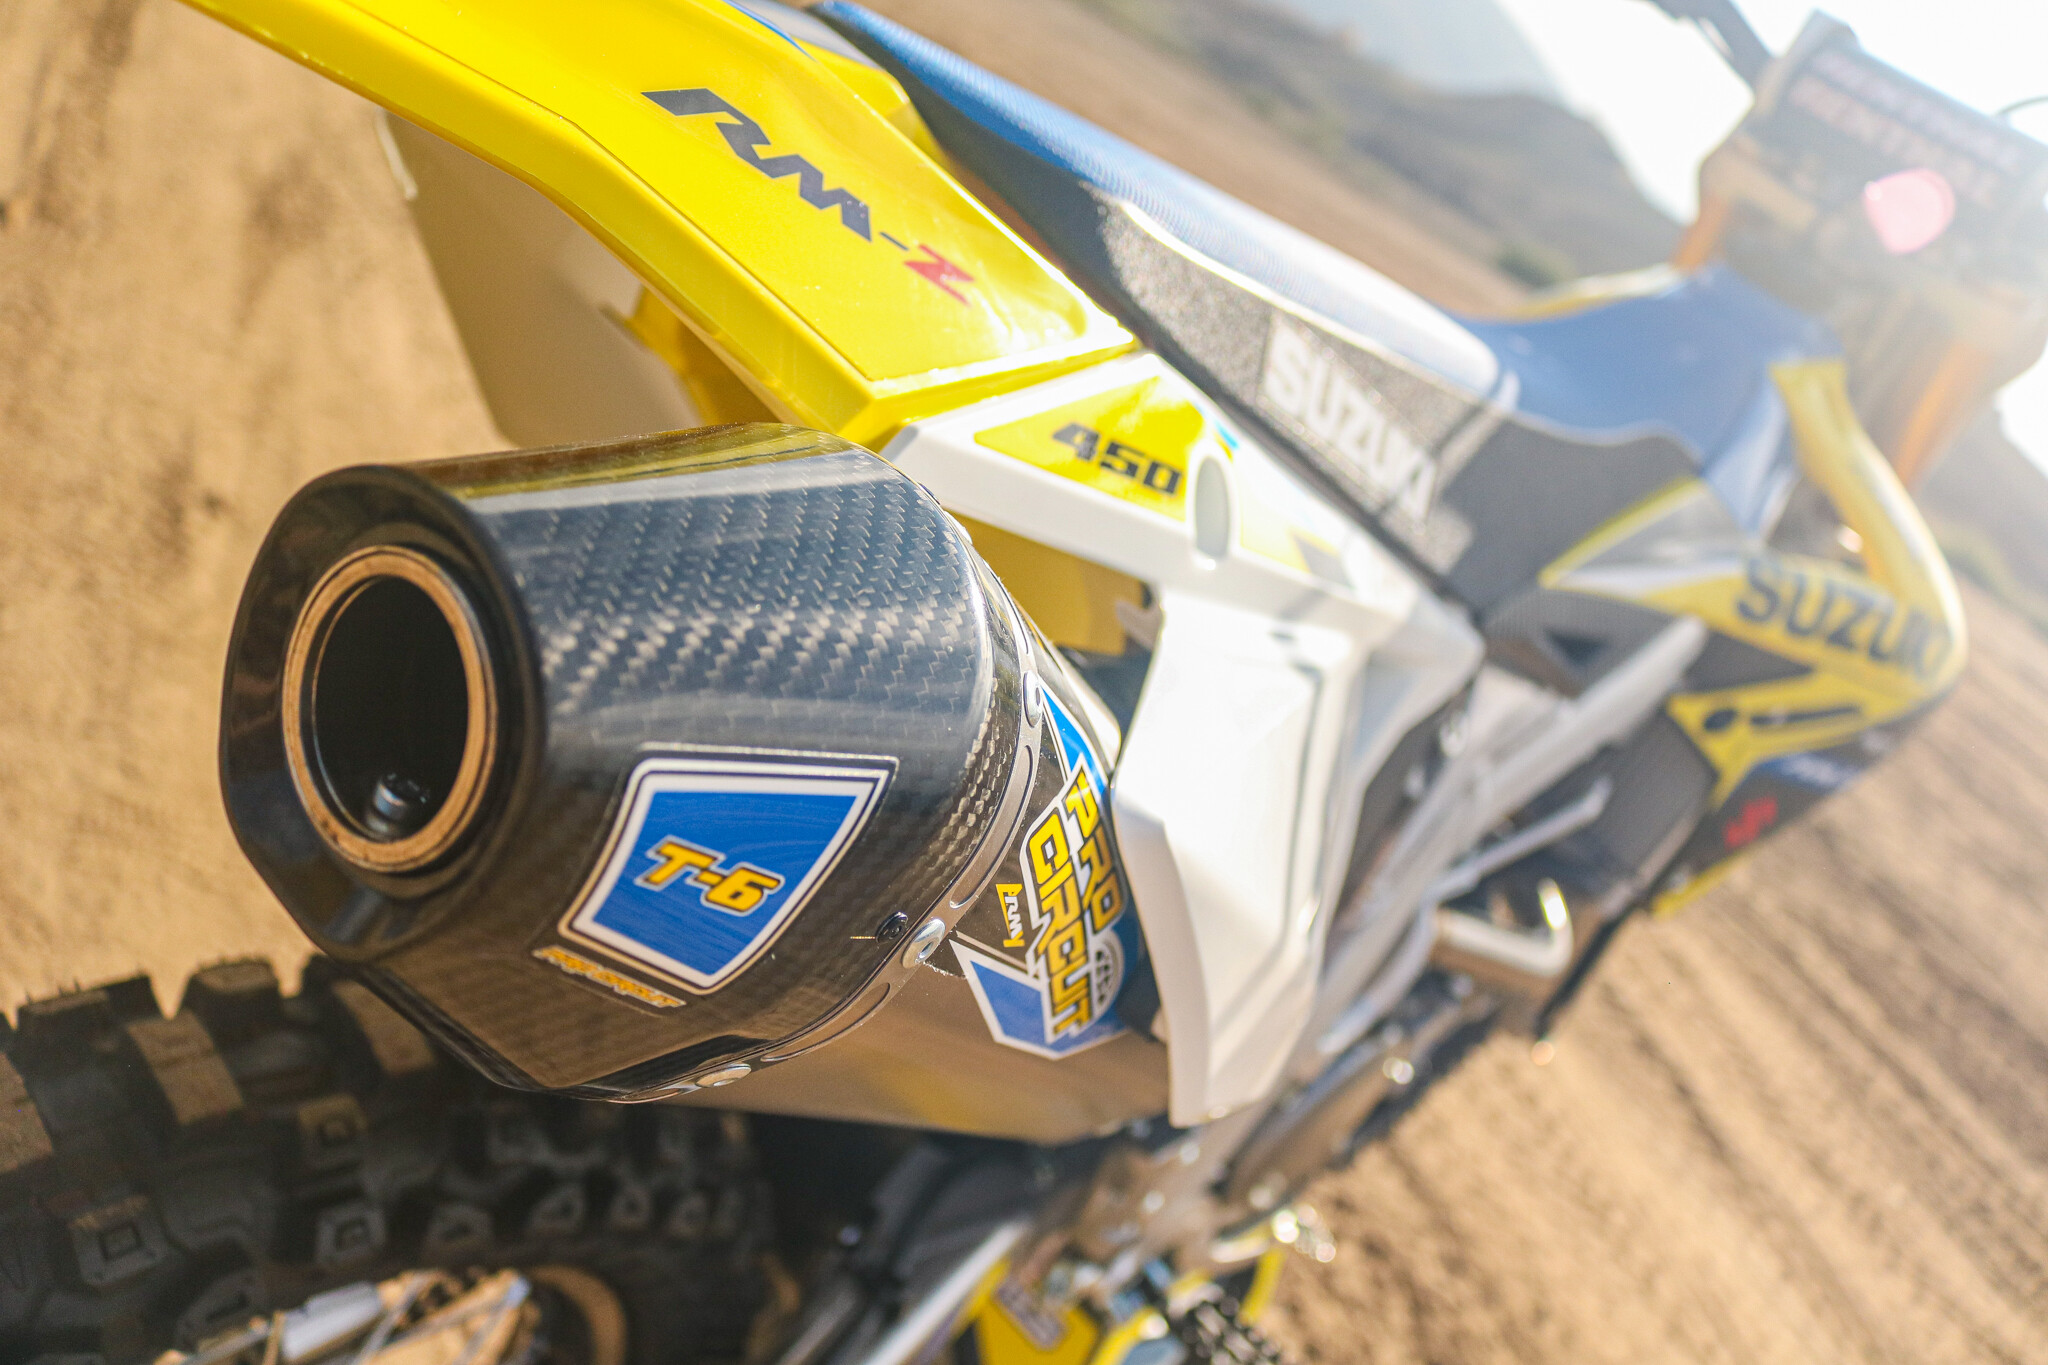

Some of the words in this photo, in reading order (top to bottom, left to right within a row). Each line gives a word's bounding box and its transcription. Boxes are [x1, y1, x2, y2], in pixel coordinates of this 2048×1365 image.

[1052, 422, 1182, 495] 450
[638, 838, 783, 915] T-6
[1062, 768, 1124, 935] PRO
[1026, 808, 1093, 1037] CIRCUIT
